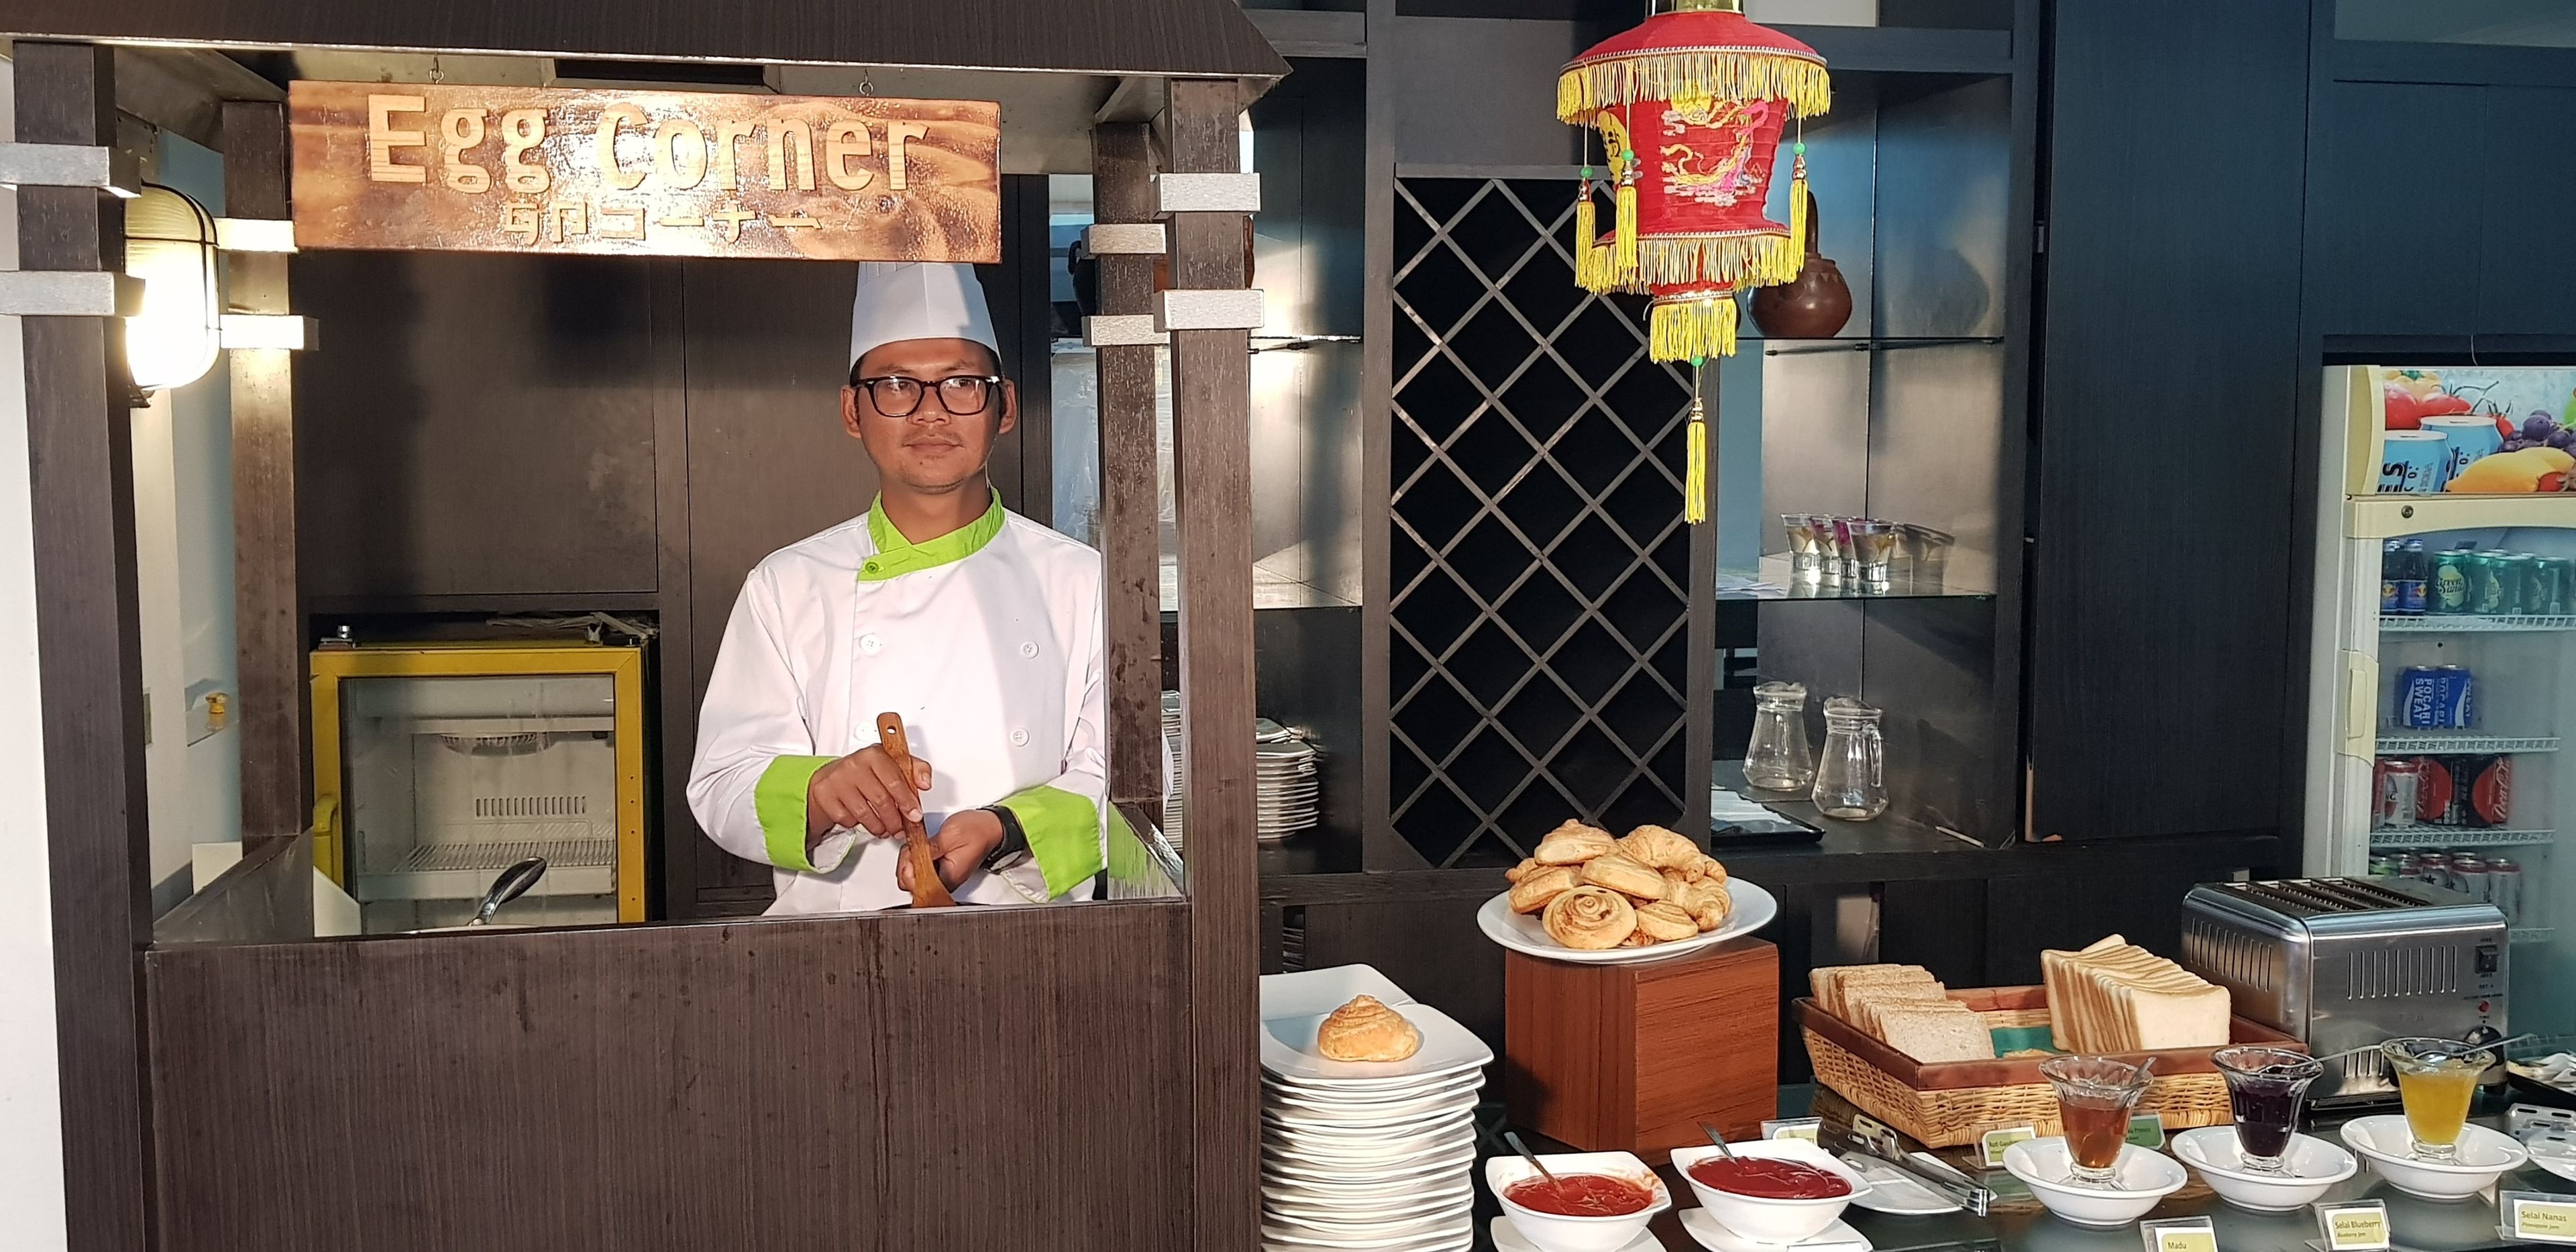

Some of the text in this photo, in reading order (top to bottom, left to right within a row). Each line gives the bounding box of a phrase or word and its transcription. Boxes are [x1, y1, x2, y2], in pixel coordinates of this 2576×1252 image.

[368, 94, 930, 193] Egg Corner
[2414, 678, 2424, 719] SWEAT
[2422, 678, 2432, 724] POCARI
[2351, 1220, 2381, 1229] Blueberry
[2521, 1211, 2567, 1222] Selai Nanas
